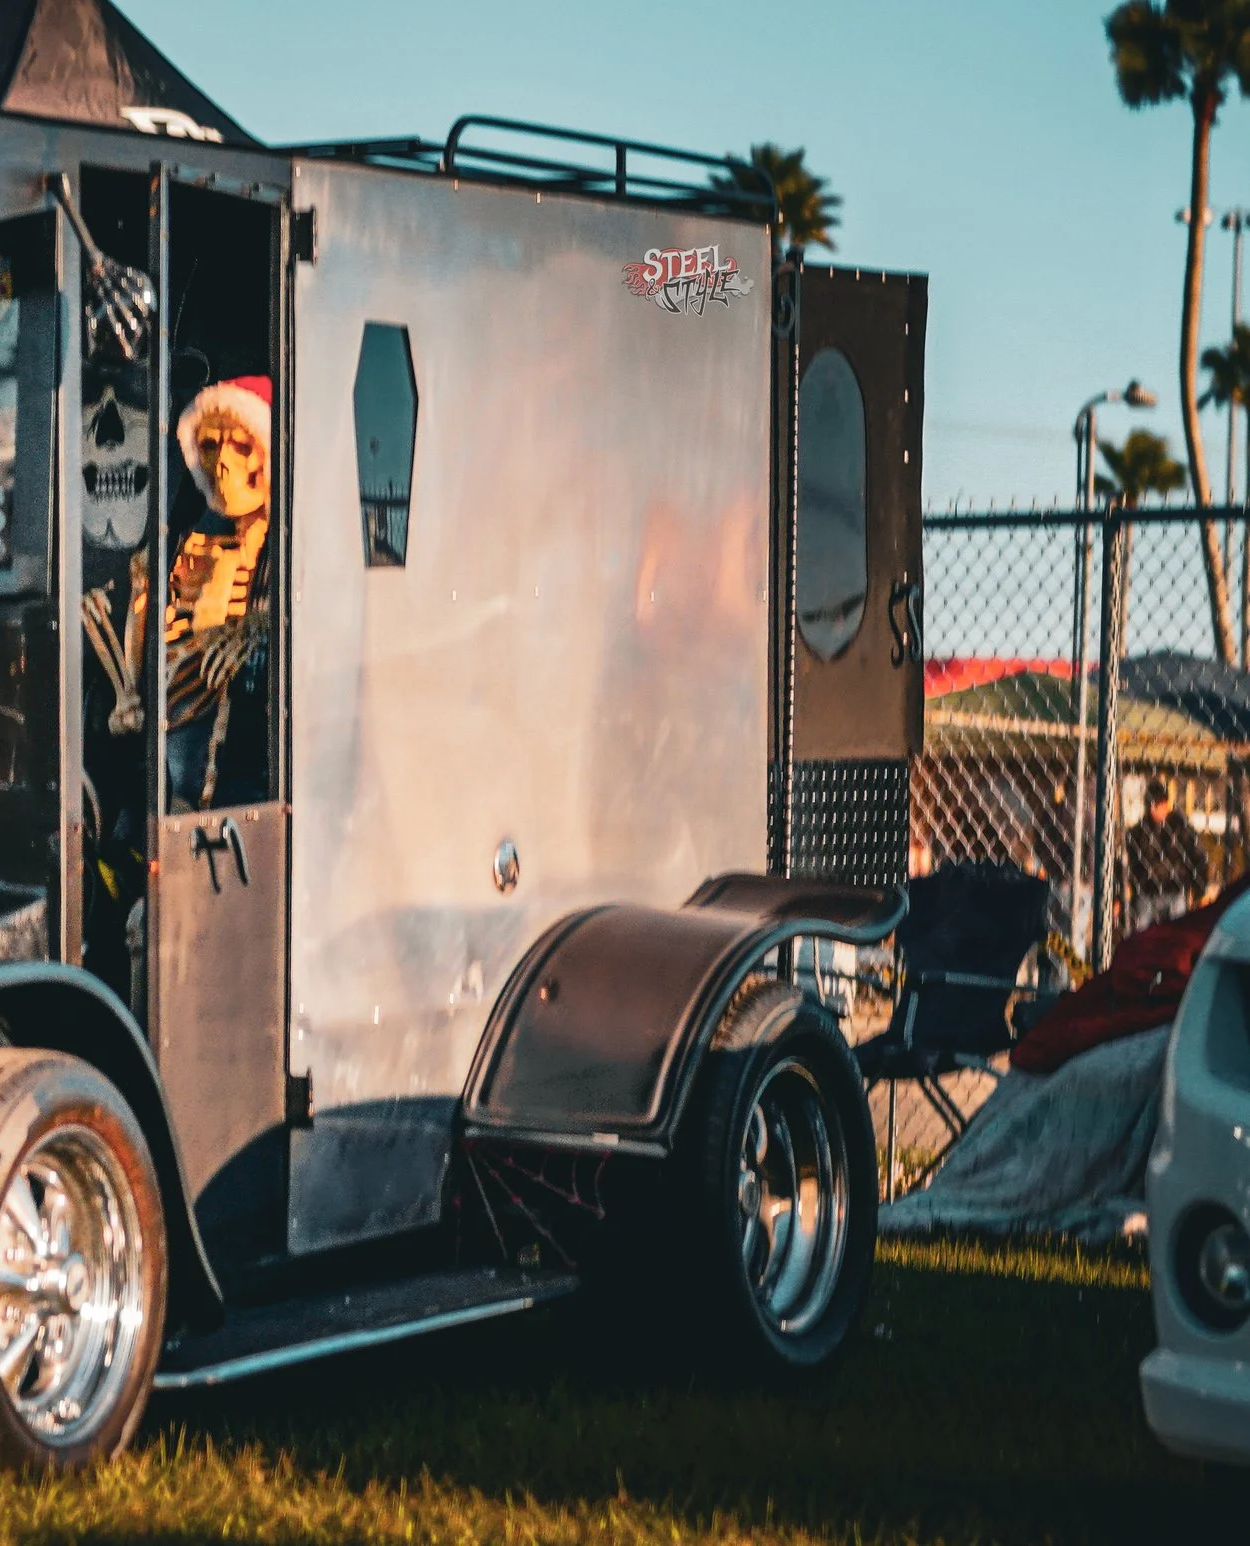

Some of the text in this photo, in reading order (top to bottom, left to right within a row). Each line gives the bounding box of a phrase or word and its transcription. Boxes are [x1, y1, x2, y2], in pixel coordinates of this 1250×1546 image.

[642, 244, 732, 284] STEEL
[646, 267, 741, 317] & STYLE
